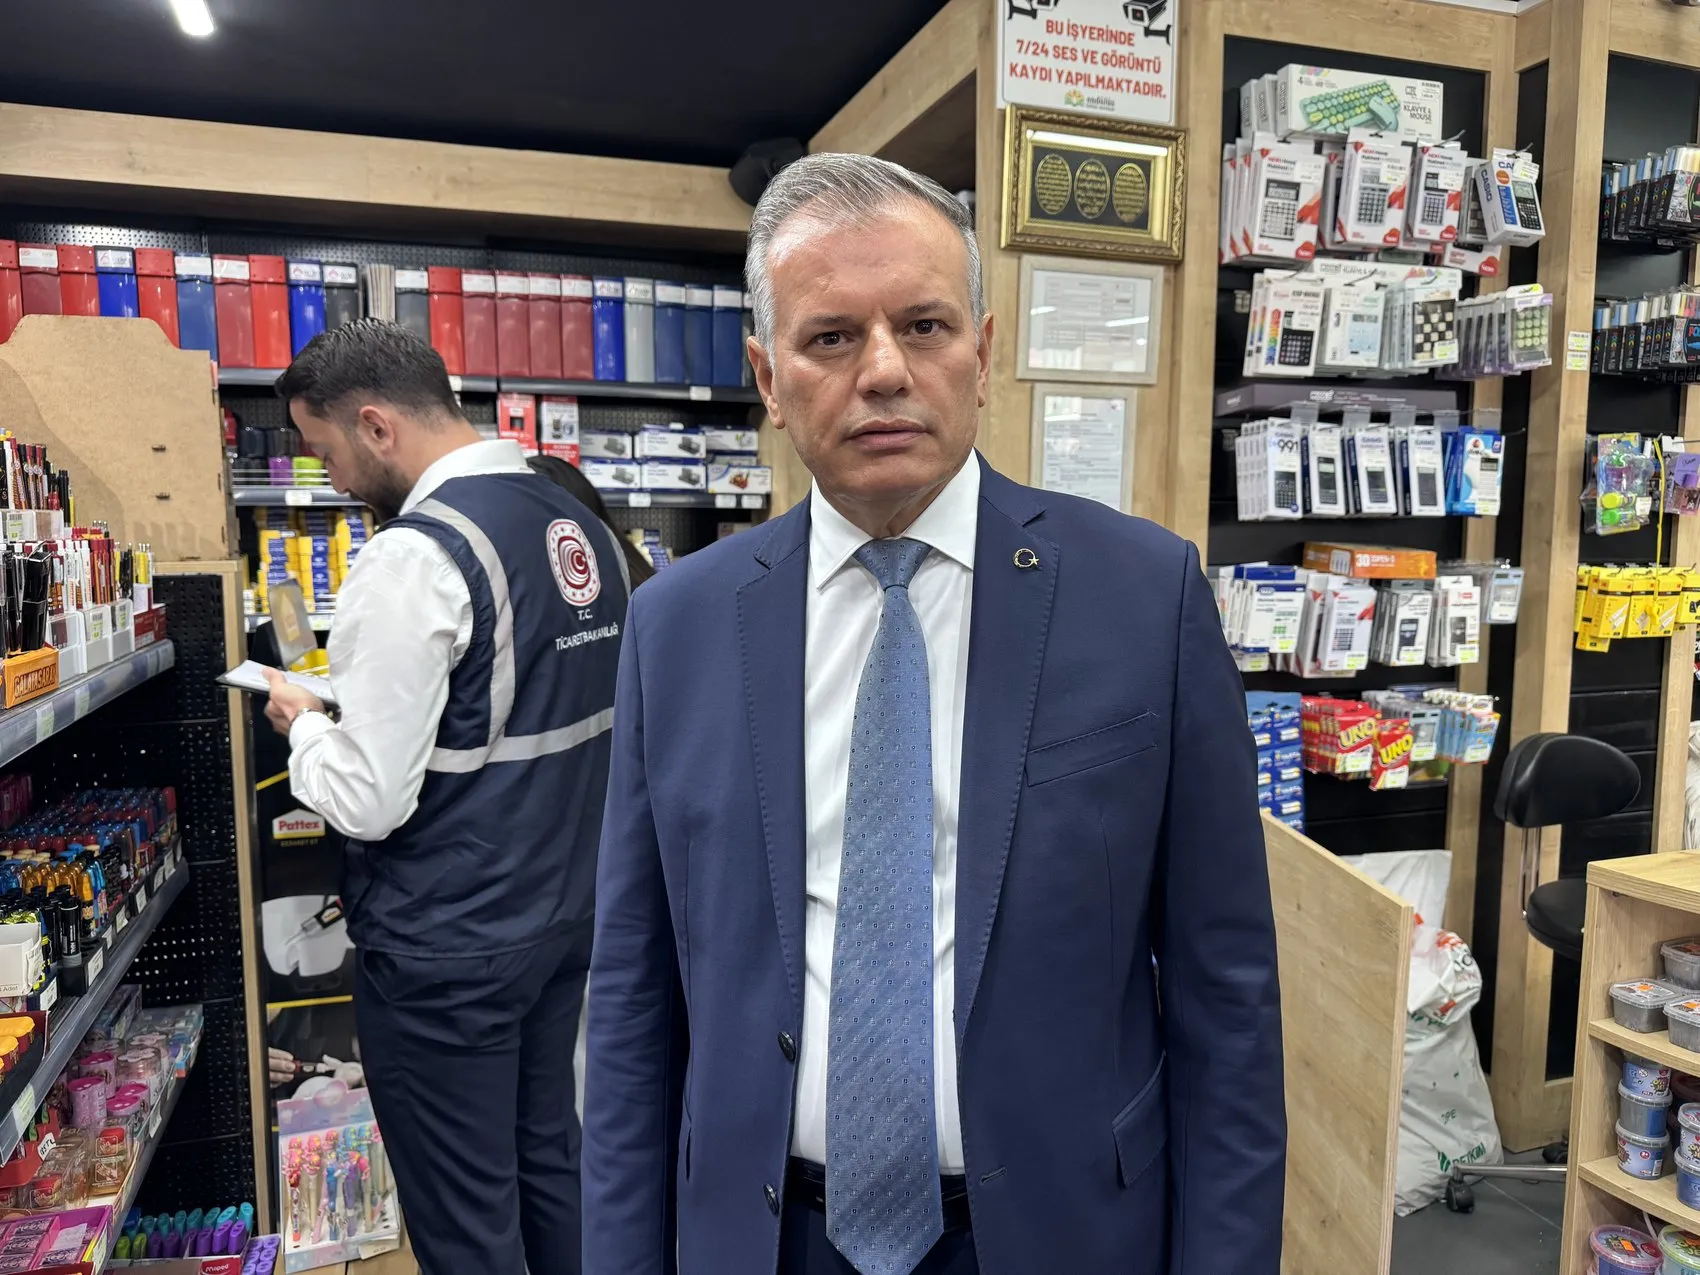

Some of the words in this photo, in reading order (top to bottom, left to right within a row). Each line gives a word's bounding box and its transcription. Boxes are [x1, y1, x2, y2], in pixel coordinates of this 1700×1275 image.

[1046, 19, 1064, 35] BU
[1067, 19, 1135, 46] İŞYERİNDE
[1016, 40, 1049, 56] 7/24
[1053, 45, 1078, 62] SES
[1082, 48, 1098, 65] VE
[1101, 48, 1162, 74] GÖRÜNTÜ
[1009, 62, 1052, 82] KAYDI
[1055, 68, 1167, 98] YAPILMAKTADIR.
[1480, 168, 1493, 202] CASIO
[577, 608, 593, 621] T.C.
[555, 632, 583, 651] TİCARET
[1339, 717, 1377, 749] UNO
[1379, 734, 1414, 766] UNO
[278, 820, 320, 831] Pattex
